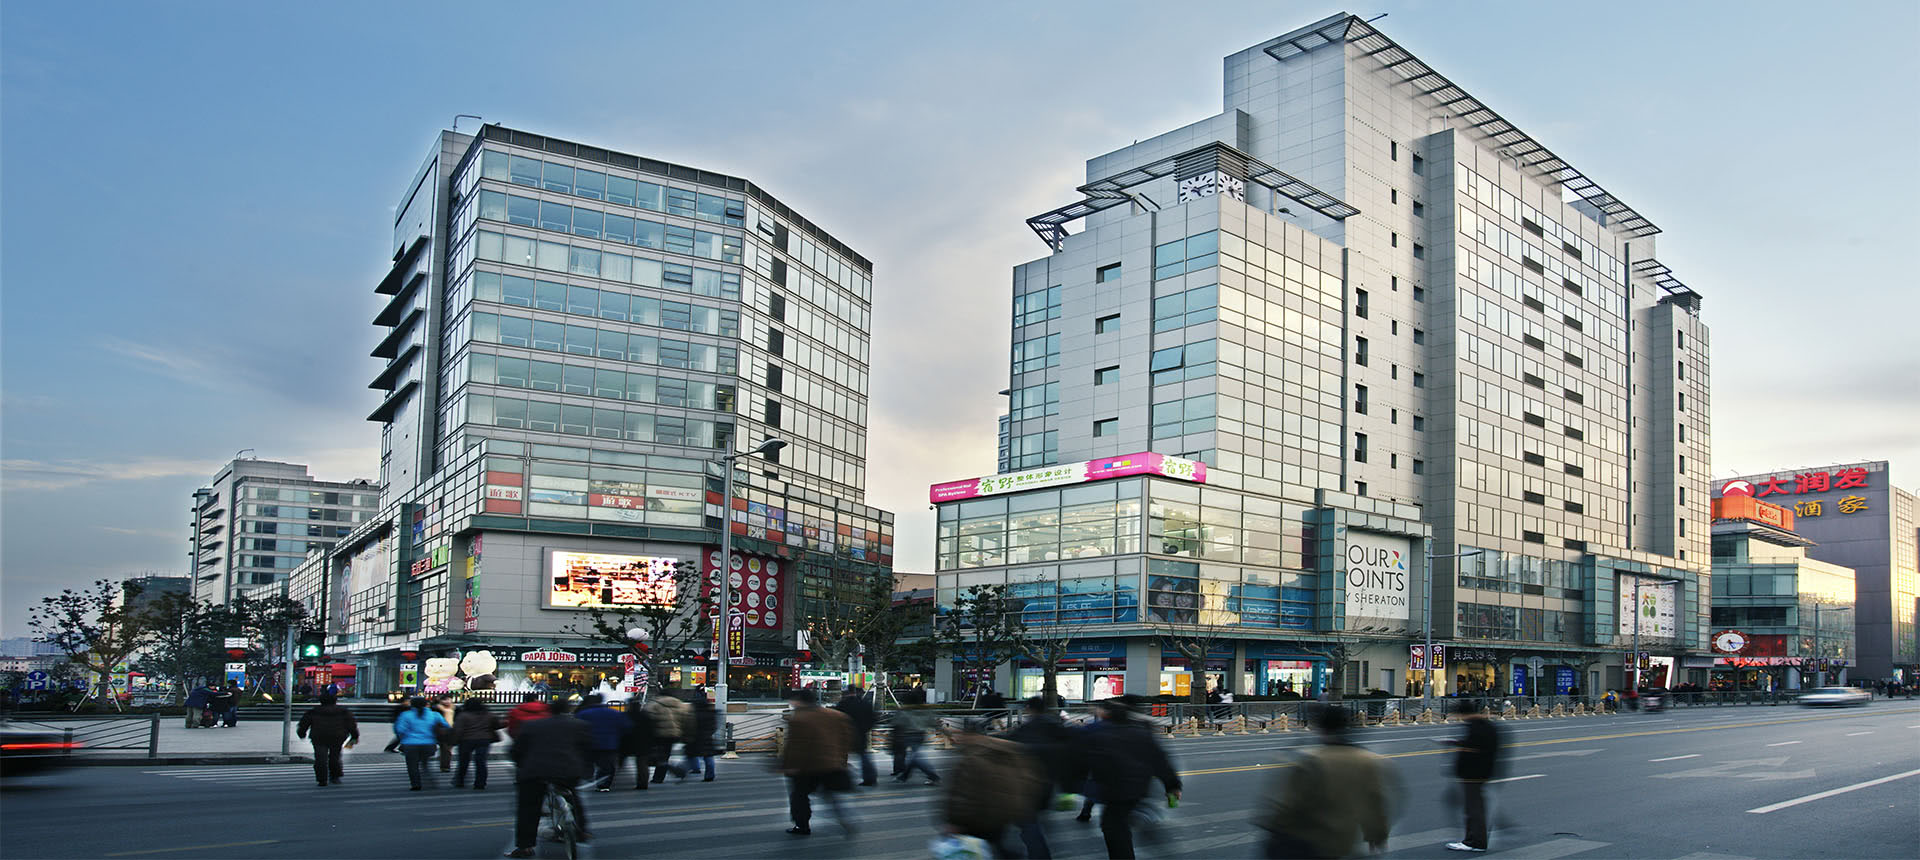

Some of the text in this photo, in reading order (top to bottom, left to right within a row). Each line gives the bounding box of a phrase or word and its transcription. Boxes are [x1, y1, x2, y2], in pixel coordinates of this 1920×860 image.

[1758, 467, 1870, 498] 大润发
[1794, 495, 1869, 518] 酒家
[1348, 544, 1390, 568] OUR
[1346, 567, 1405, 592] OINTS
[1354, 592, 1406, 607] SHERATON
[524, 650, 546, 662] PAPA
[547, 650, 575, 662] JOHNS
[30, 681, 43, 689] P
